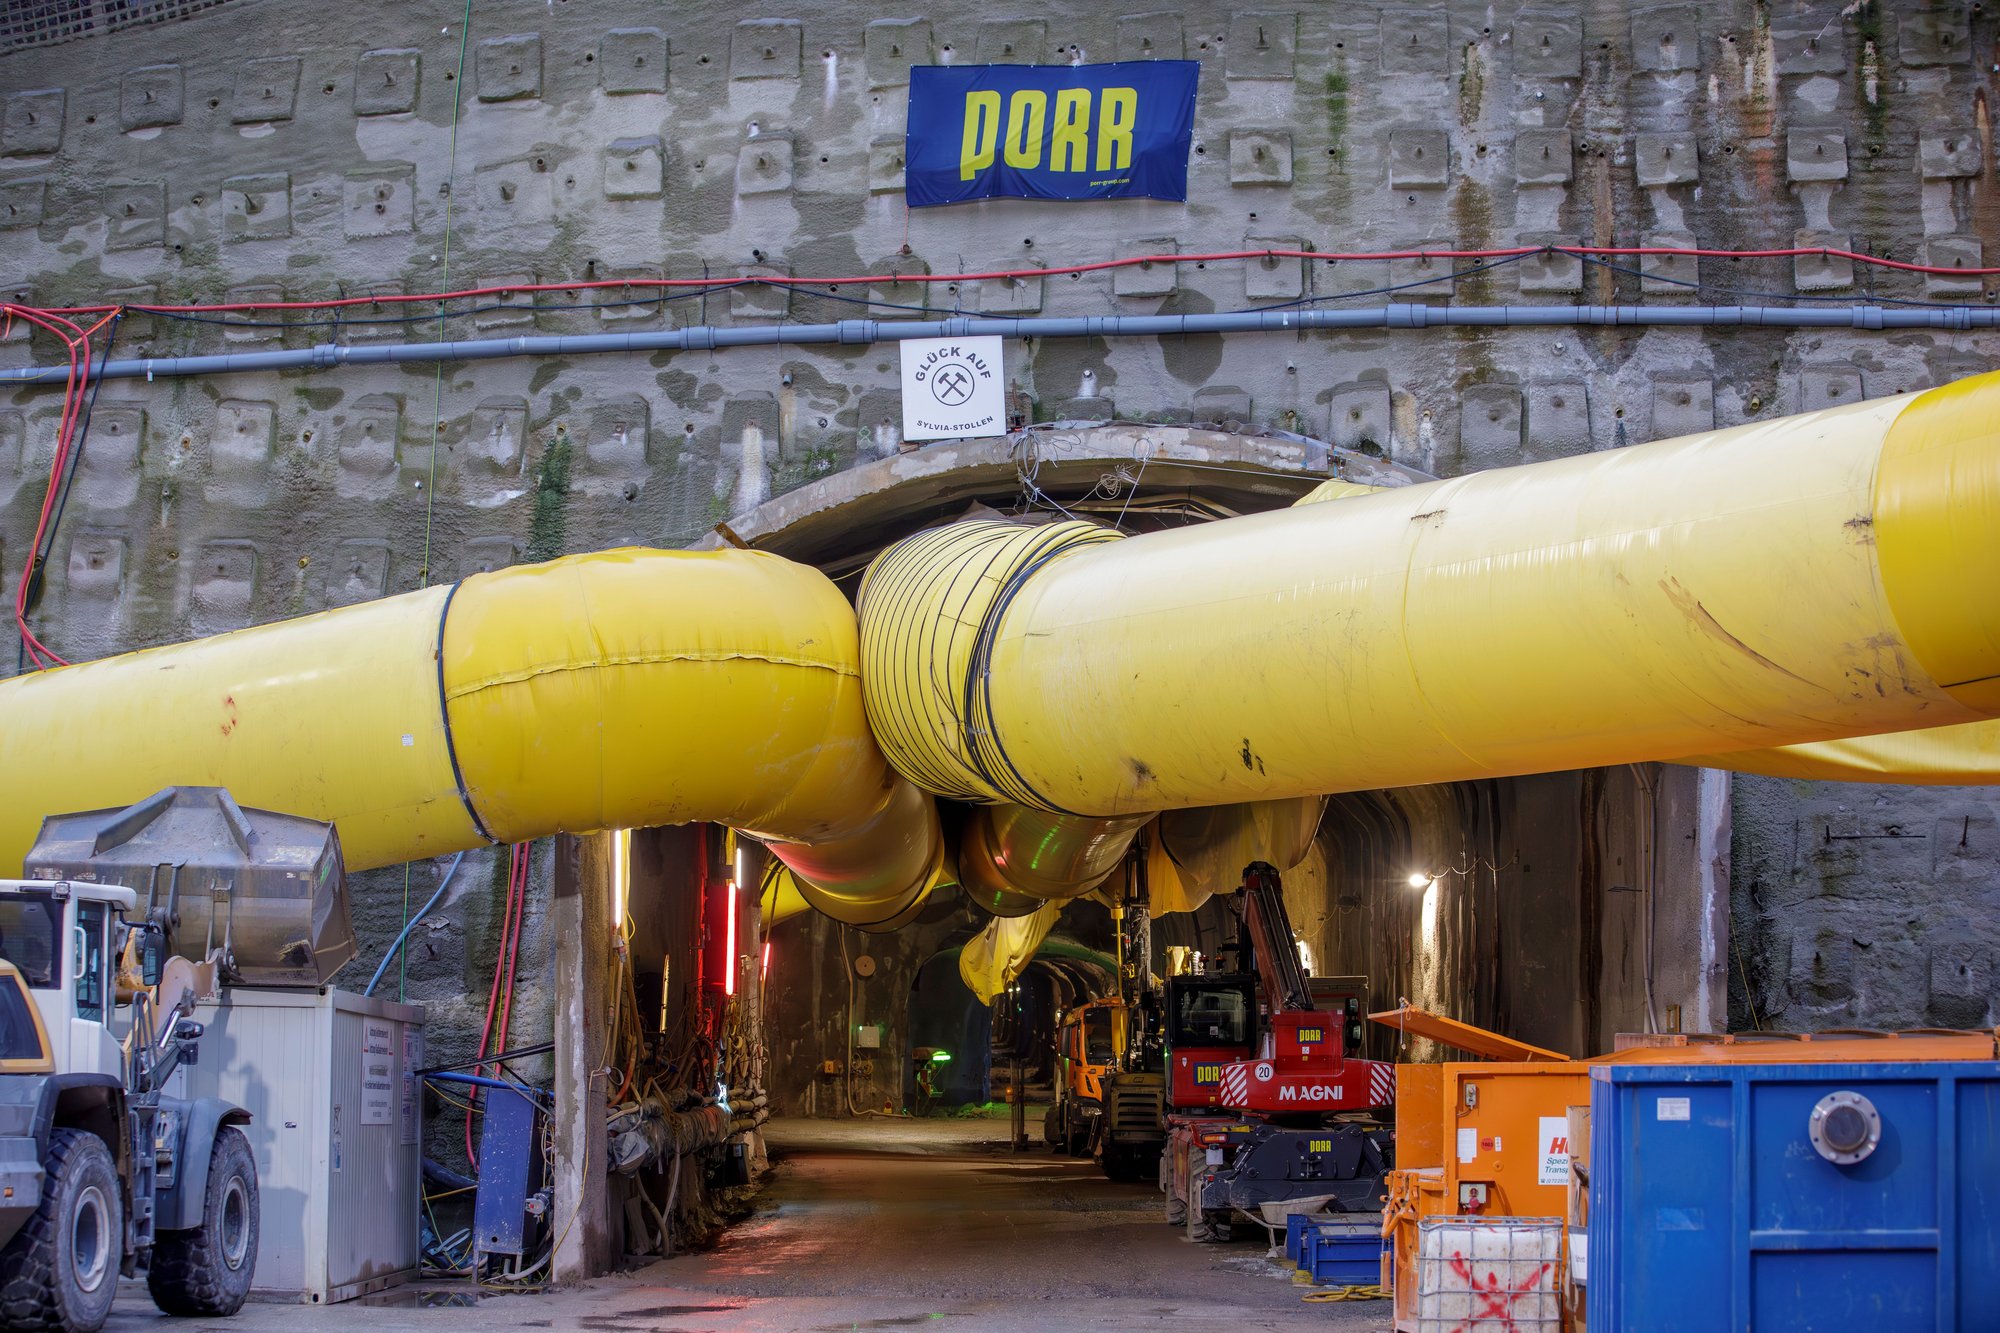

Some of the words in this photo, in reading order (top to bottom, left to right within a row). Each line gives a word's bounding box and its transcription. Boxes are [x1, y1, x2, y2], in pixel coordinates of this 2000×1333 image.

[960, 87, 1137, 181] PORR
[1090, 178, 1130, 187] porr-group.com
[916, 347, 961, 381] GLÜCK
[966, 352, 991, 379] AUF
[917, 416, 994, 431] SYLVIA-STOLLEN
[1300, 1029, 1321, 1042] PORR
[1197, 1066, 1222, 1084] POR
[1258, 1067, 1270, 1078] 20
[1279, 1085, 1343, 1101] MAGNI
[1310, 1140, 1332, 1153] PORR
